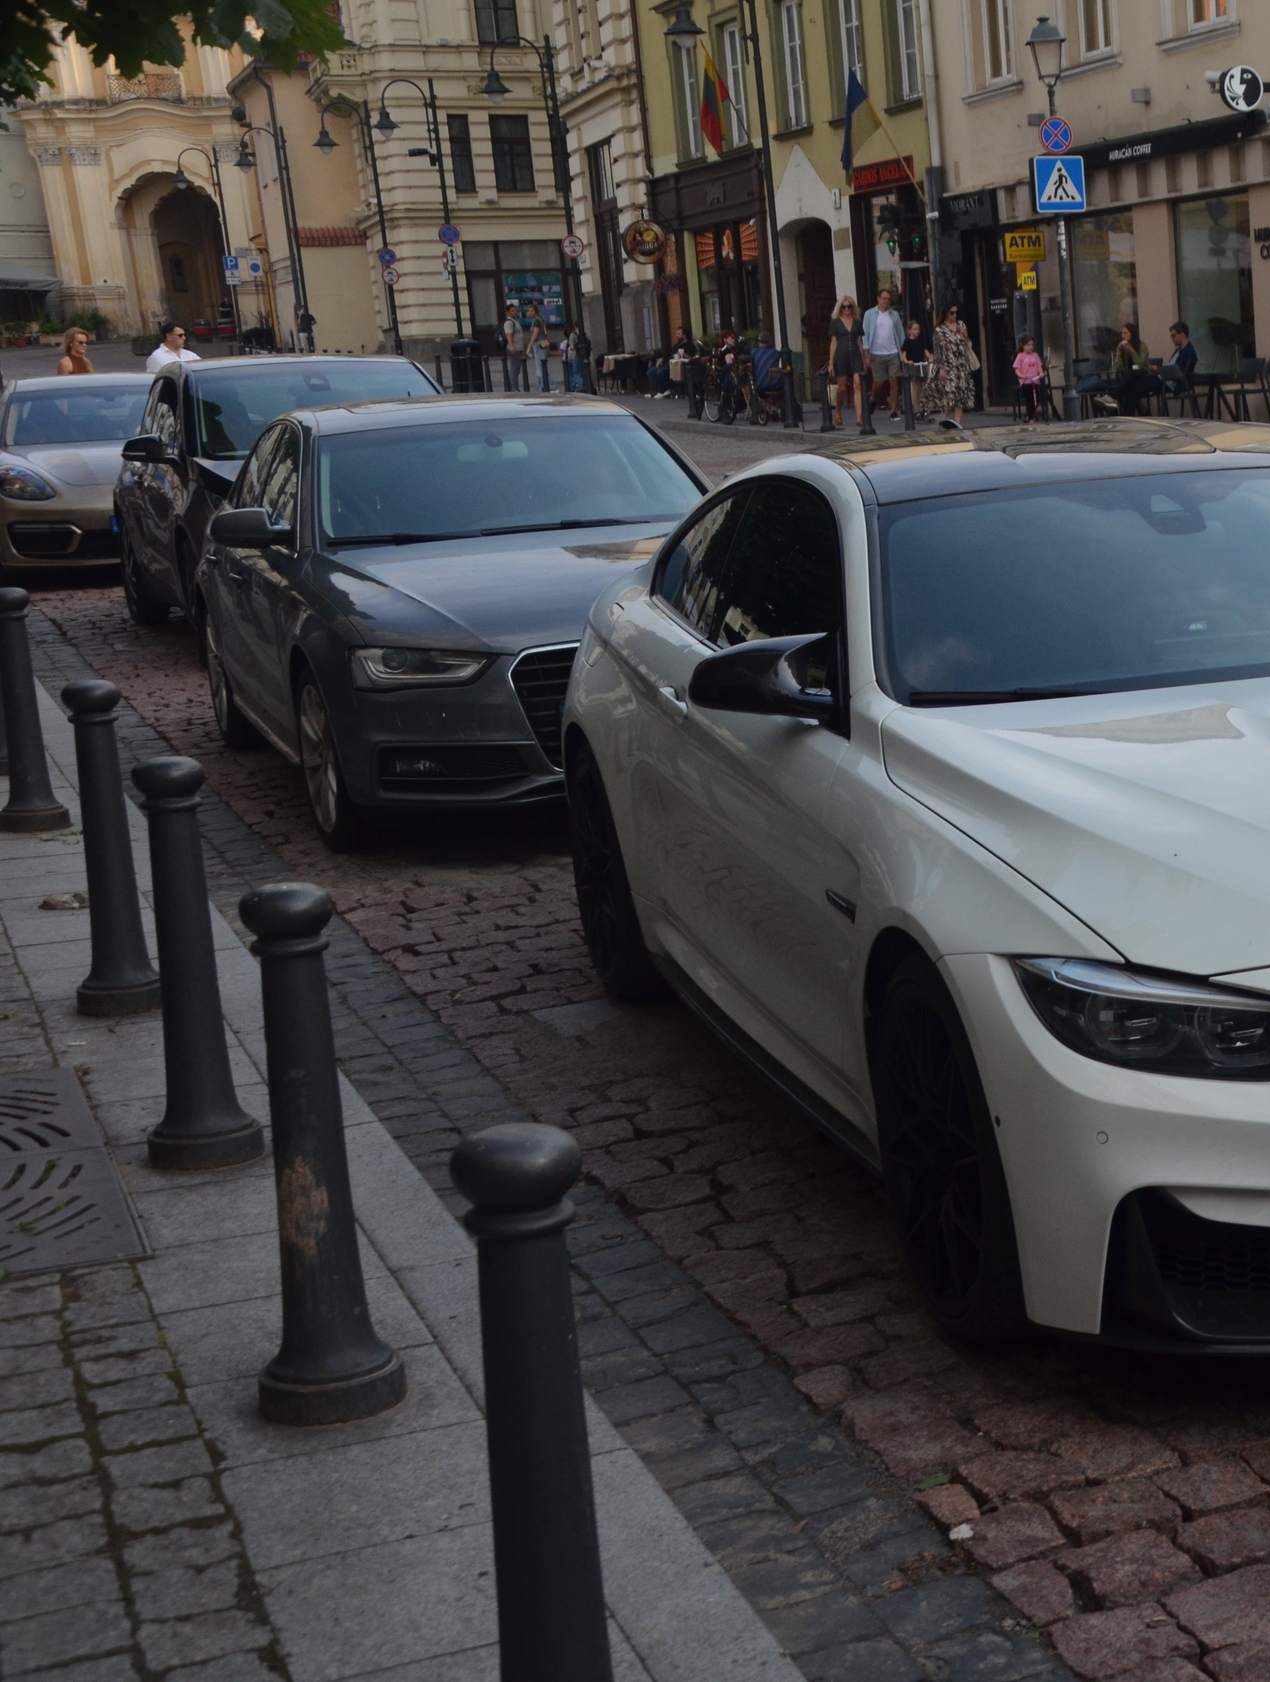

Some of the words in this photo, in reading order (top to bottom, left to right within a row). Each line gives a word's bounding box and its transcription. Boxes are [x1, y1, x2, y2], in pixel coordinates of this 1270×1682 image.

[1108, 144, 1132, 160] HURACÁN
[1132, 143, 1152, 156] COFFEE
[1009, 235, 1042, 248] ATM
[1023, 275, 1036, 286] ATM
